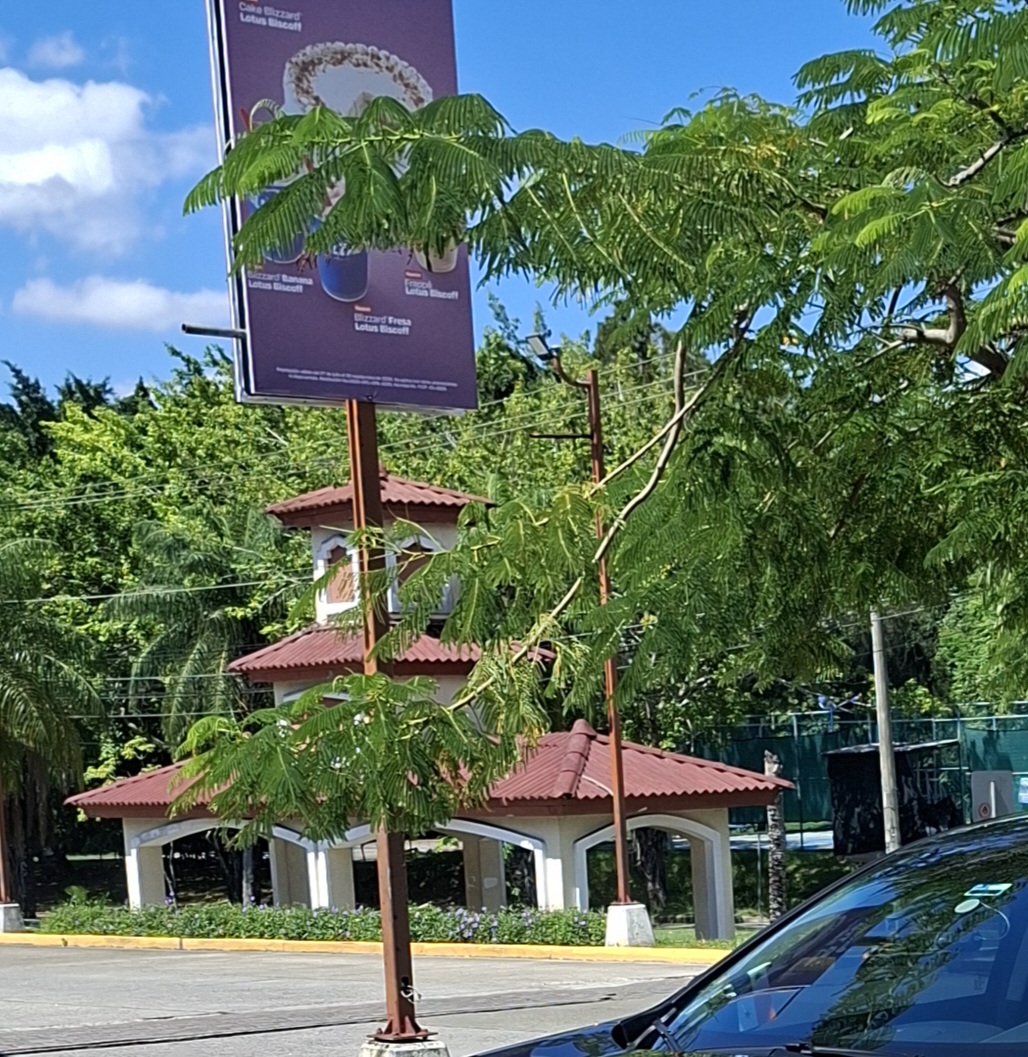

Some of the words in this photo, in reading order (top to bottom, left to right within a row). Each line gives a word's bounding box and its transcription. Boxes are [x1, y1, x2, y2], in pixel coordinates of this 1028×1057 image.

[239, 2, 263, 14] Cake
[240, 12, 267, 26] Lotus
[268, 17, 302, 32] Biscoff
[282, 274, 313, 285] Banana
[248, 280, 272, 290] Lotus
[273, 282, 303, 293] Biscoff
[405, 287, 428, 297] Lotus
[430, 289, 459, 300] Biscoff
[388, 316, 412, 326] Fresa
[355, 322, 378, 333] Lotus
[380, 325, 410, 335] Biscoff
